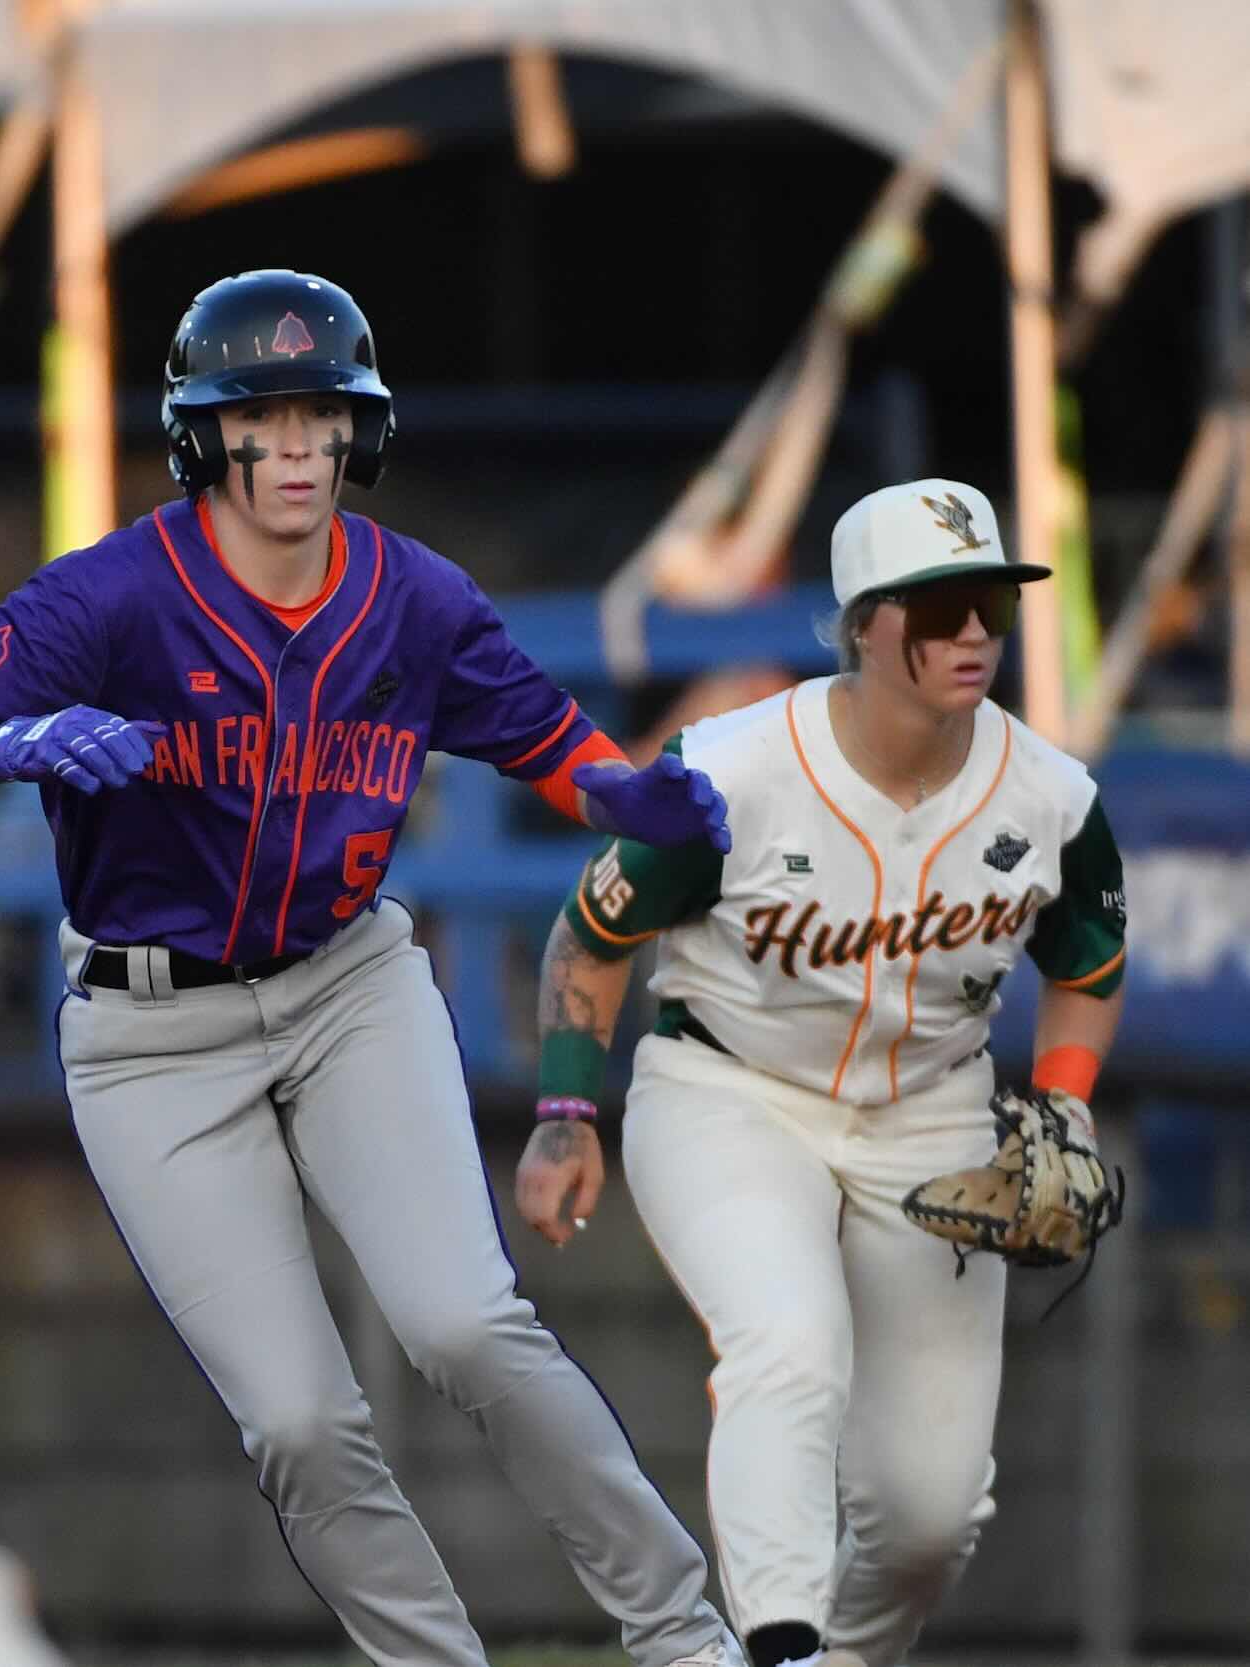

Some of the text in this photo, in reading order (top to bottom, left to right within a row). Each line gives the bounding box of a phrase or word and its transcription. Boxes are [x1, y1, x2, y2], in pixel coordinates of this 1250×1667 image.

[143, 714, 416, 805] AN FRANCISCO
[331, 828, 395, 919] 5
[744, 885, 1038, 979] Hunters
